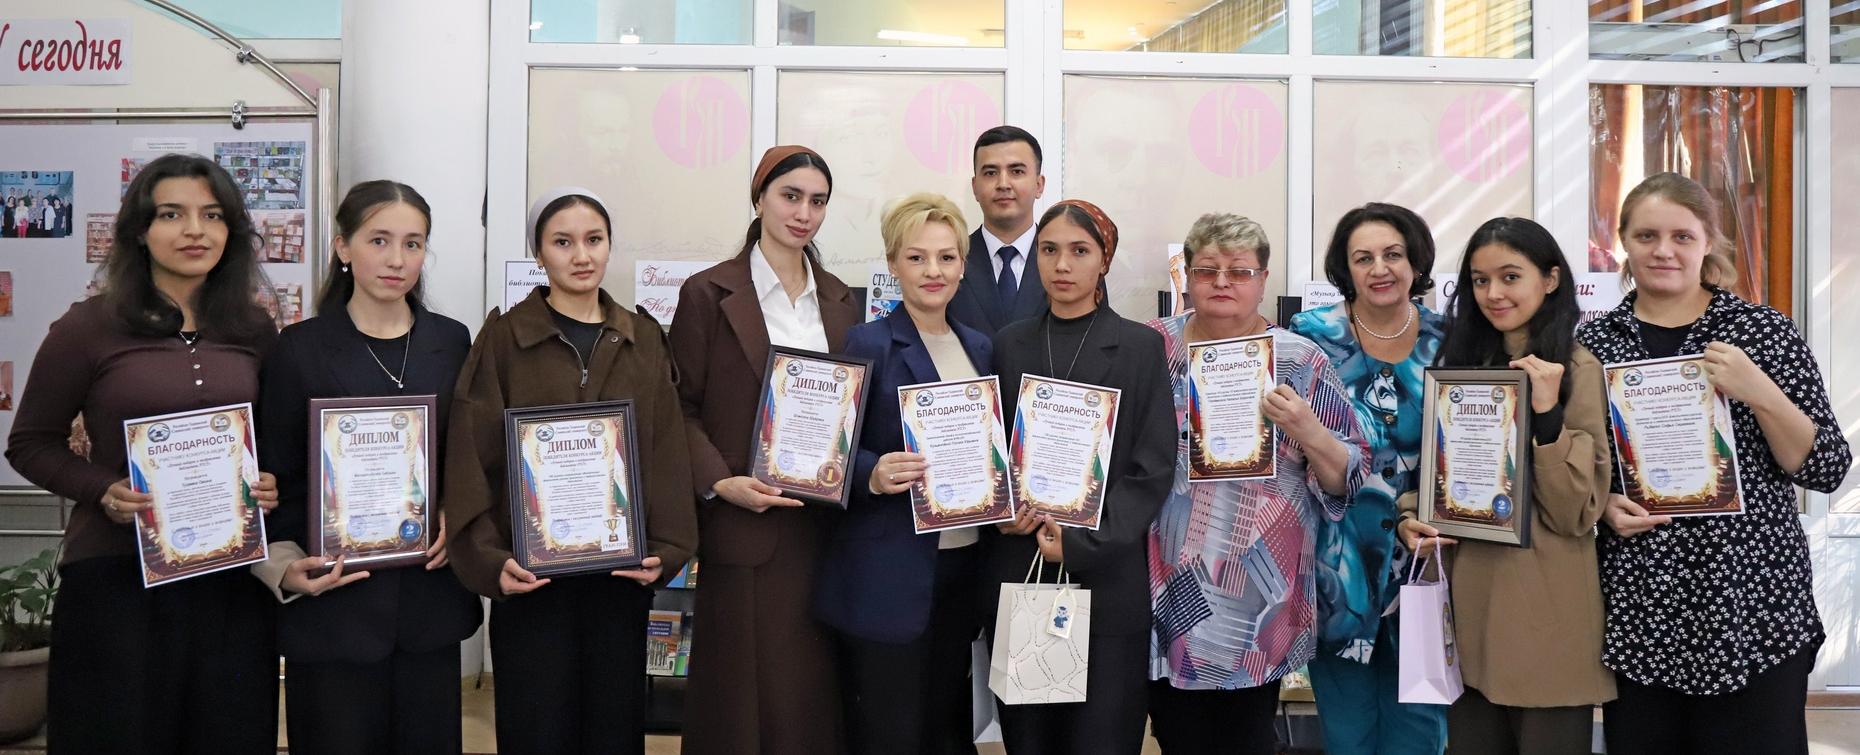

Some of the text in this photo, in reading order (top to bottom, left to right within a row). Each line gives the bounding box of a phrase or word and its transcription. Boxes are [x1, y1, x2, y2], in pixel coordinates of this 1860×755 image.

[18, 20, 122, 71] сегодня
[872, 273, 898, 289] СТУДЕ
[1201, 360, 1262, 374] БЛАГОДАРНОСТЬ
[792, 377, 838, 394] ДИПЛОМ
[1624, 382, 1706, 398] БЛАГОДАРНОСТЬ
[916, 402, 986, 418] БЛАГОДАРНОСТЬ
[1032, 401, 1101, 419] БЛАГОДАРНОСТЬ
[1456, 403, 1497, 416] ДИПЛОМ
[147, 434, 236, 456] БЛАГОДАРНОСТЬ
[350, 431, 399, 446] ДИПЛОМ
[547, 437, 597, 454] ДИПЛОМ
[1498, 500, 1506, 510] 2
[406, 525, 415, 535] 2
